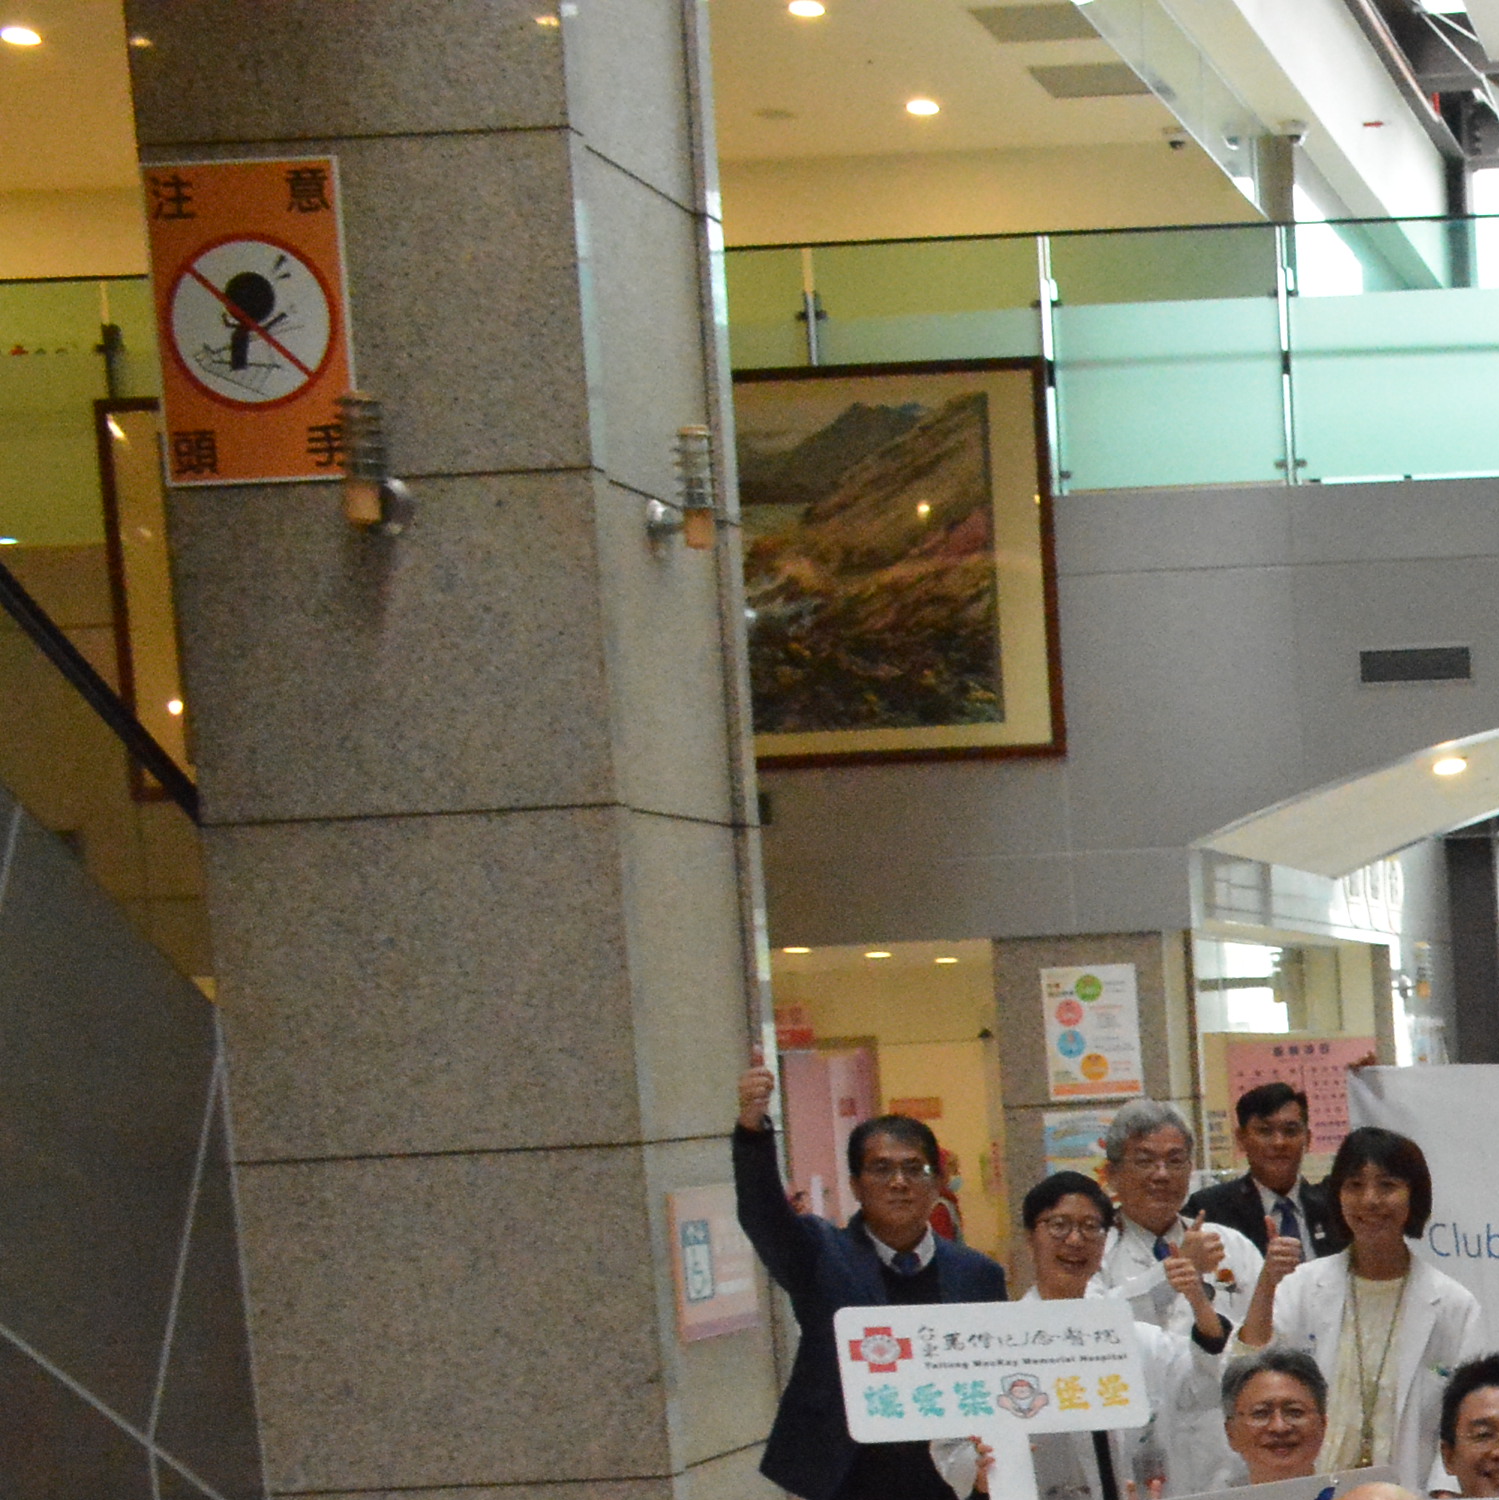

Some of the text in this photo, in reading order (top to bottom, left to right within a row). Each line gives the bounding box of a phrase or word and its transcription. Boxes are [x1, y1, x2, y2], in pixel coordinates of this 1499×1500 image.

[150, 167, 330, 220] 注意
[172, 423, 346, 475] 頭手
[924, 1352, 1128, 1371] Taitung MacKay Memorial Hospital
